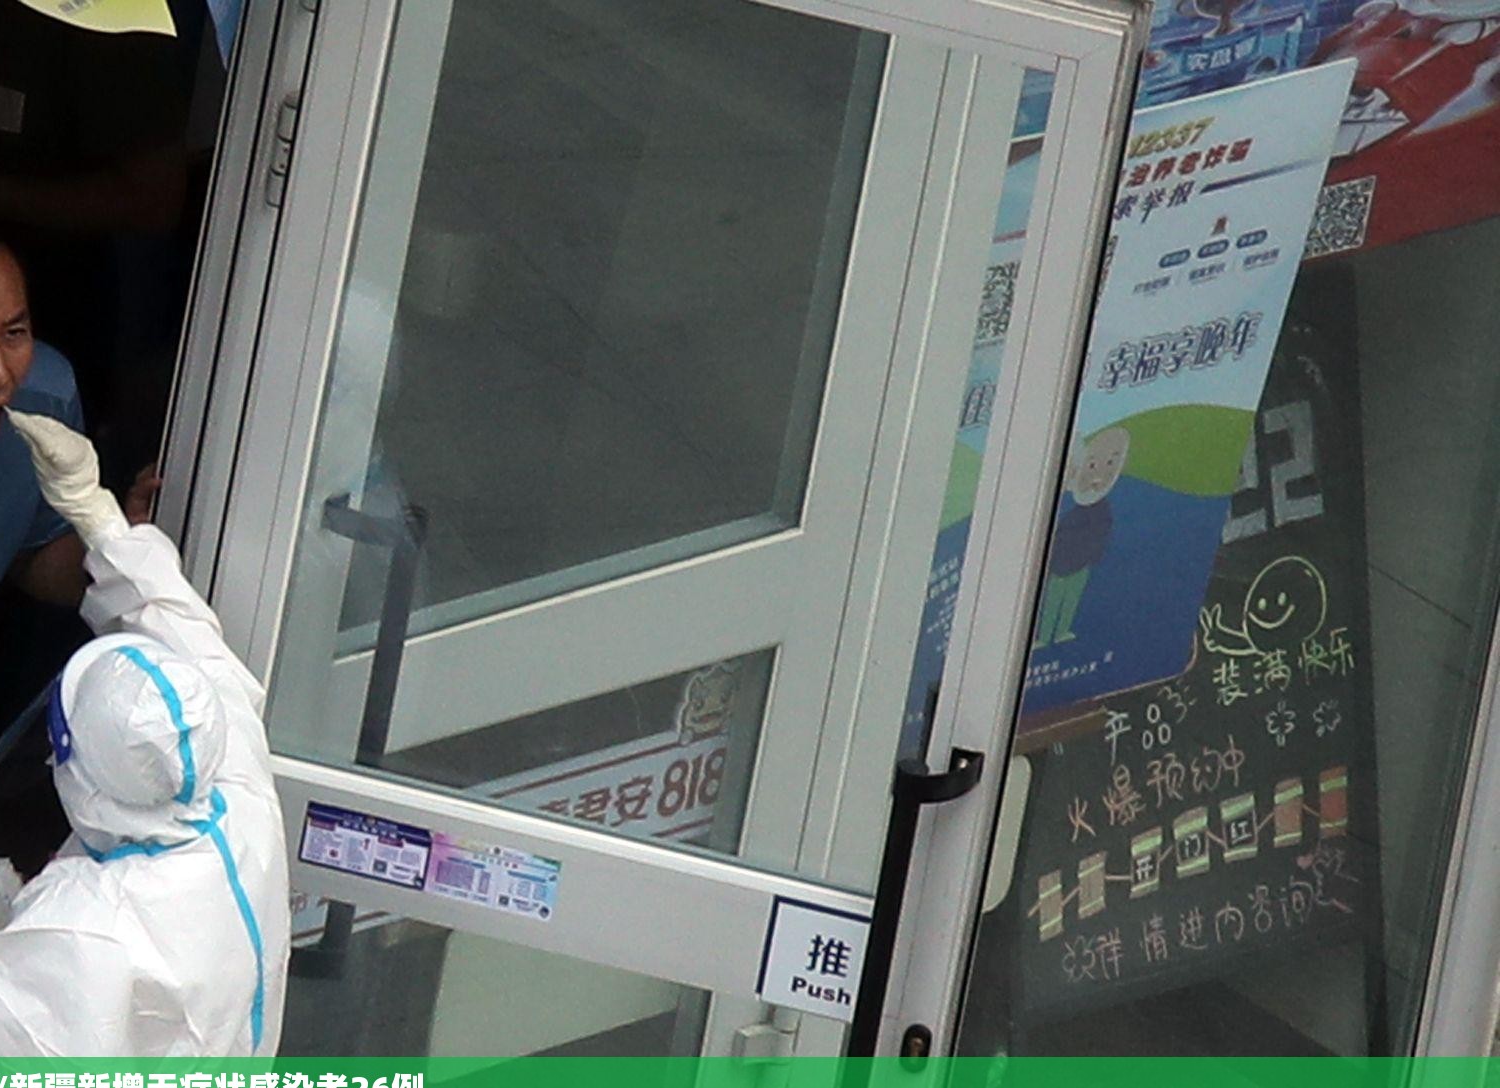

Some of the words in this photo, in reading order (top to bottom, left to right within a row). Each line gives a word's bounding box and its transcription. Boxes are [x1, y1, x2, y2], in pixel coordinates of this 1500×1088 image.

[1120, 137, 1253, 188] 治养老诈骗
[1100, 312, 1263, 392] 幸福享晚年
[1212, 626, 1355, 706] 装满快乐
[1104, 702, 1173, 767] 产品
[1067, 733, 1245, 843] 火爆预约中
[805, 933, 852, 979] 推
[790, 975, 852, 1006] Push
